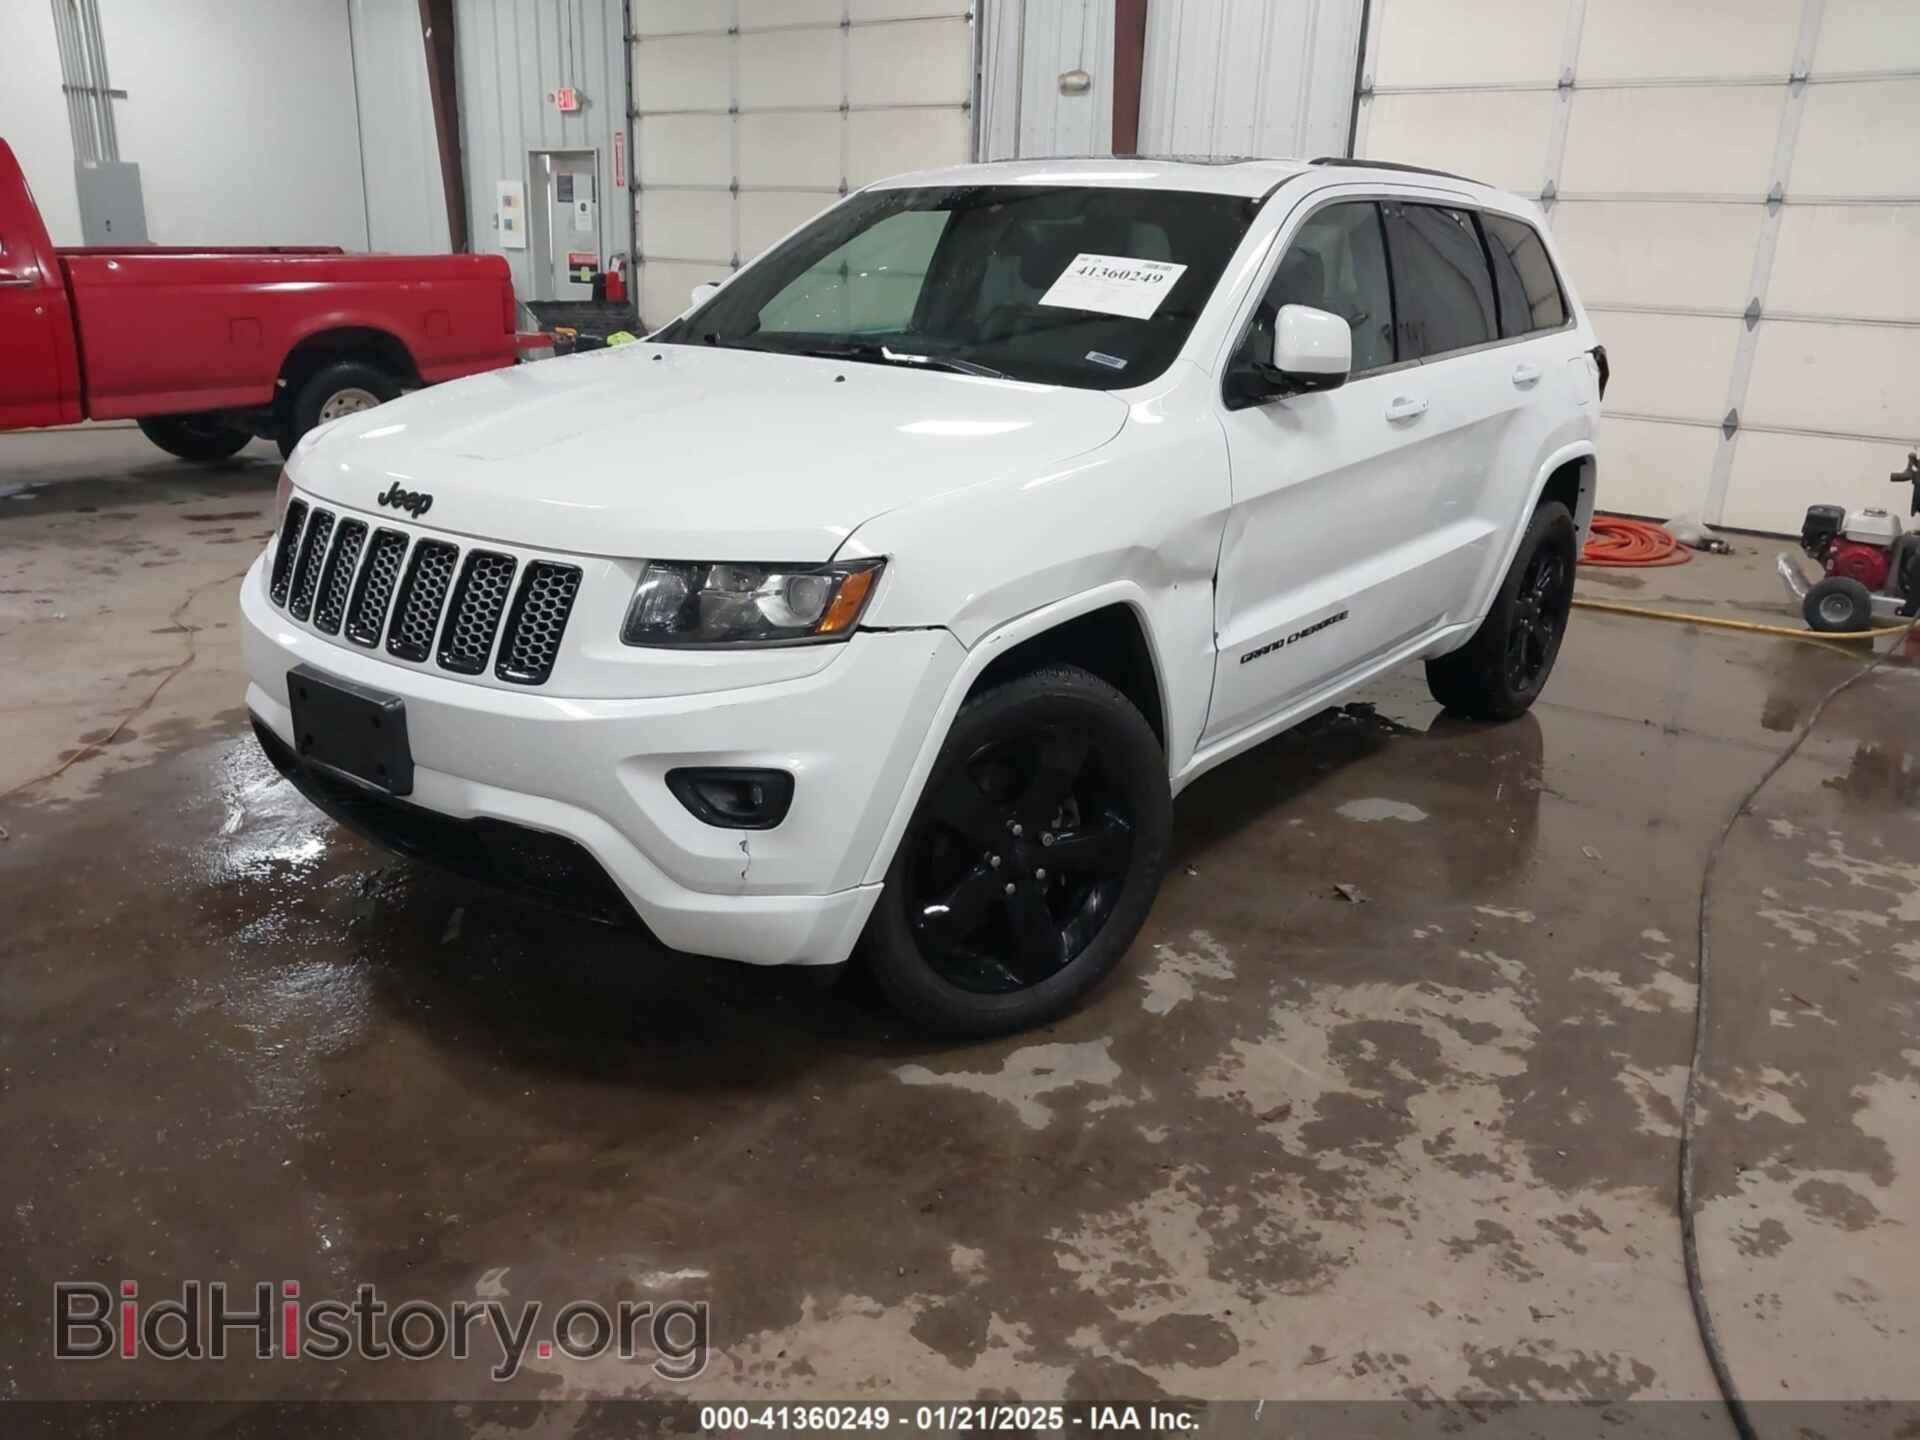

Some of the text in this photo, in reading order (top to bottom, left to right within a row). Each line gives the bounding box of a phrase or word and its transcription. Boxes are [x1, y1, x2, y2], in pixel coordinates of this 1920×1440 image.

[1076, 265, 1164, 283] 41360249
[377, 481, 434, 520] Jeep
[1240, 610, 1349, 665] GRAND CHEROKEE
